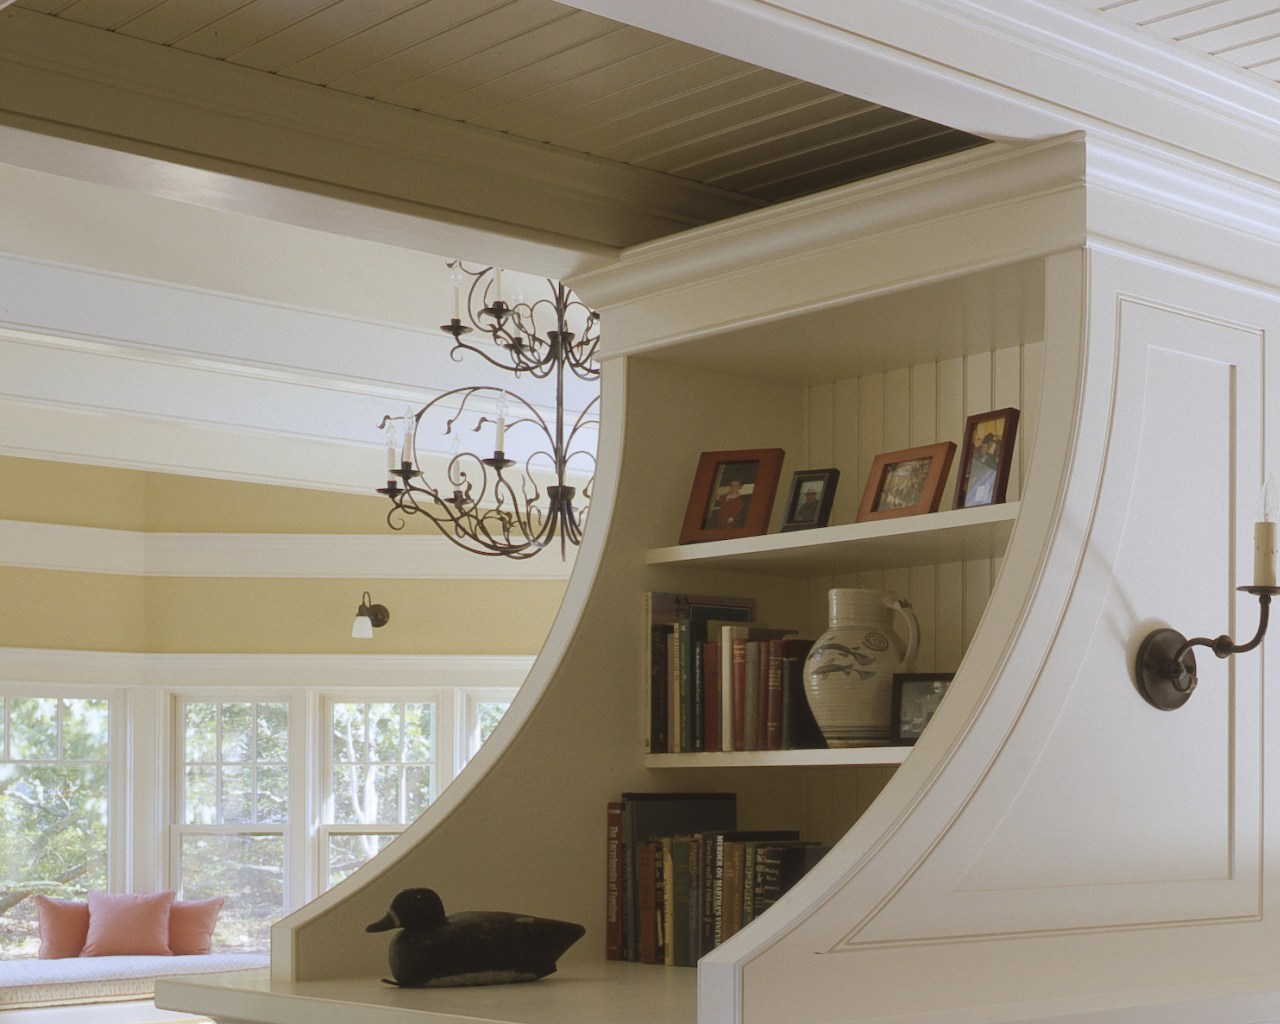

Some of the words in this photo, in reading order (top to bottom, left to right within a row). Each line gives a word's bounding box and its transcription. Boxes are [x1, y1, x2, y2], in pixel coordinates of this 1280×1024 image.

[716, 834, 724, 866] MURDER
[716, 867, 723, 878] ON
[714, 916, 722, 948] VINEYAR
